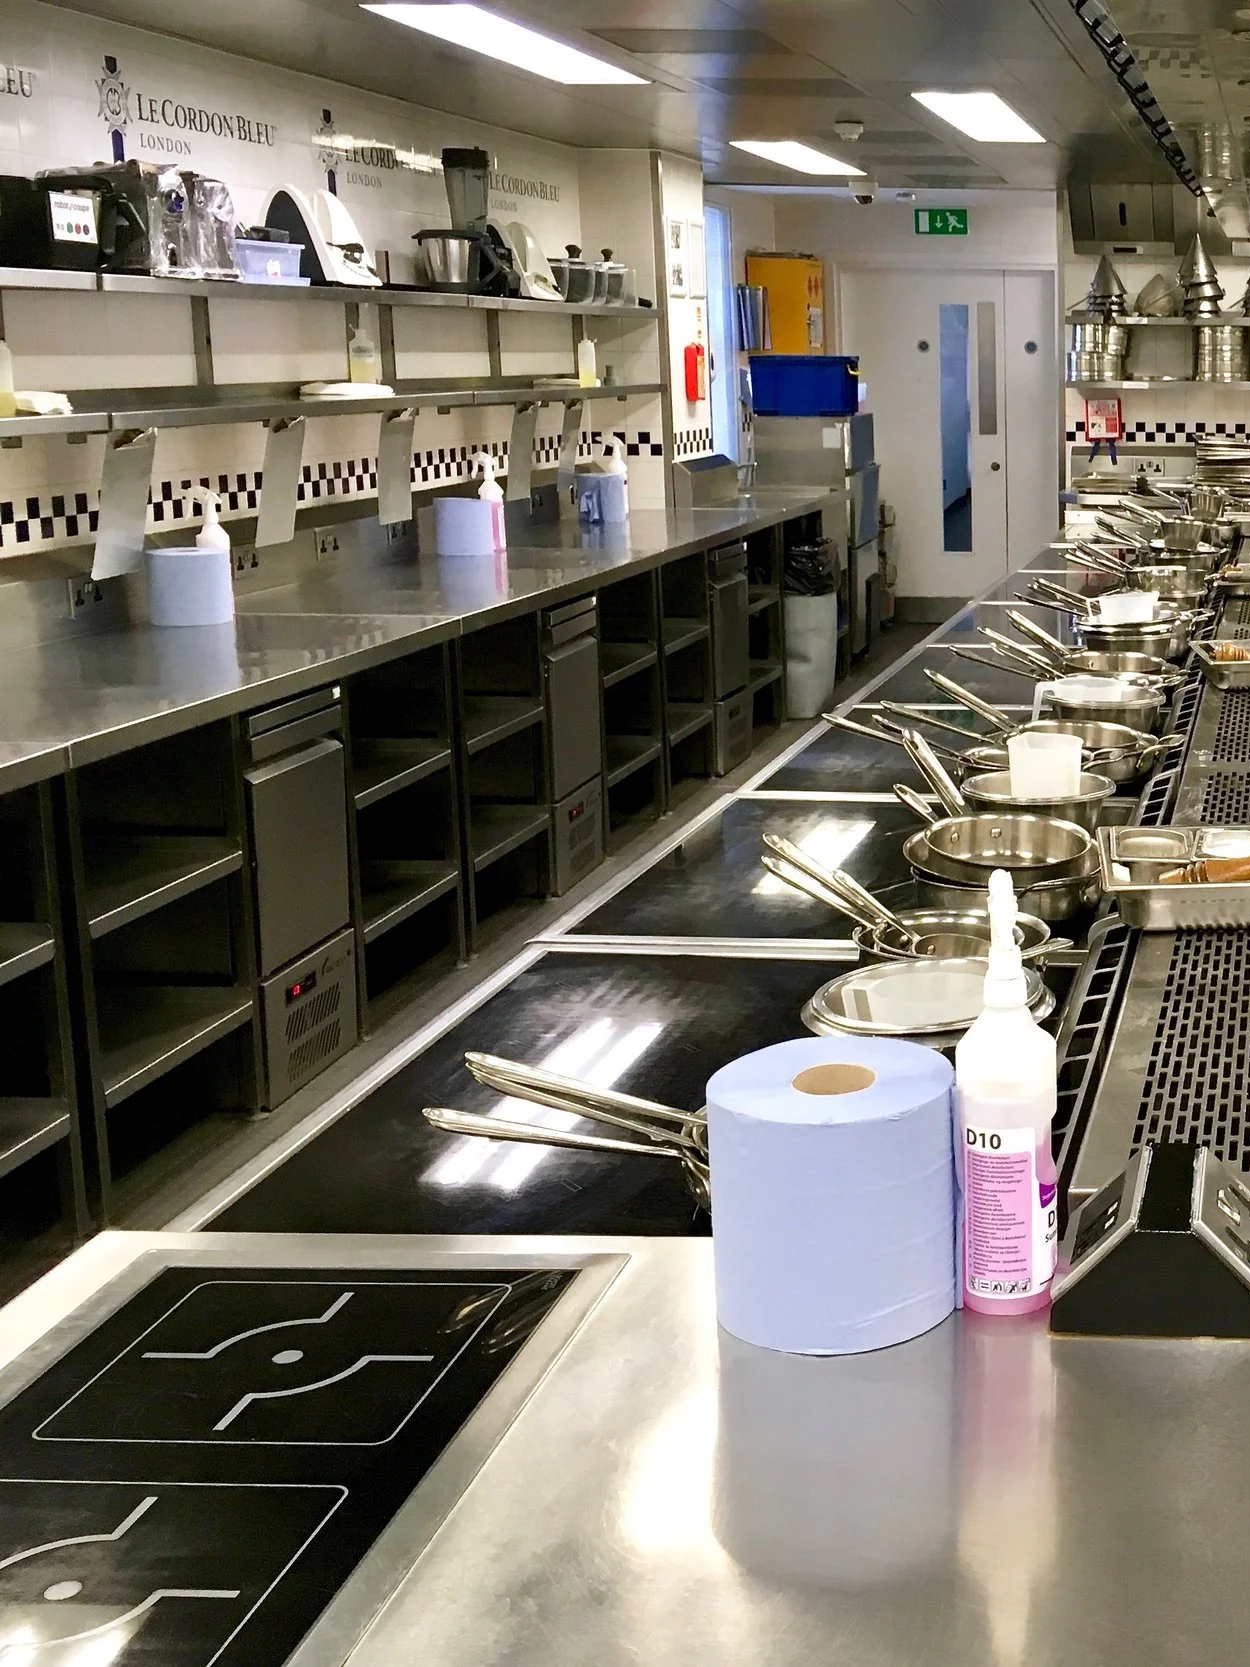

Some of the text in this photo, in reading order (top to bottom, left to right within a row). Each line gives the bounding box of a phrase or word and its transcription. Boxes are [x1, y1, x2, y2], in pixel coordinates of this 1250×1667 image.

[136, 93, 275, 147] LE CORDON BLEU
[139, 132, 192, 155] LONDON
[346, 171, 383, 189] LONDON
[501, 173, 539, 198] CORDON
[966, 1127, 1002, 1150] D10
